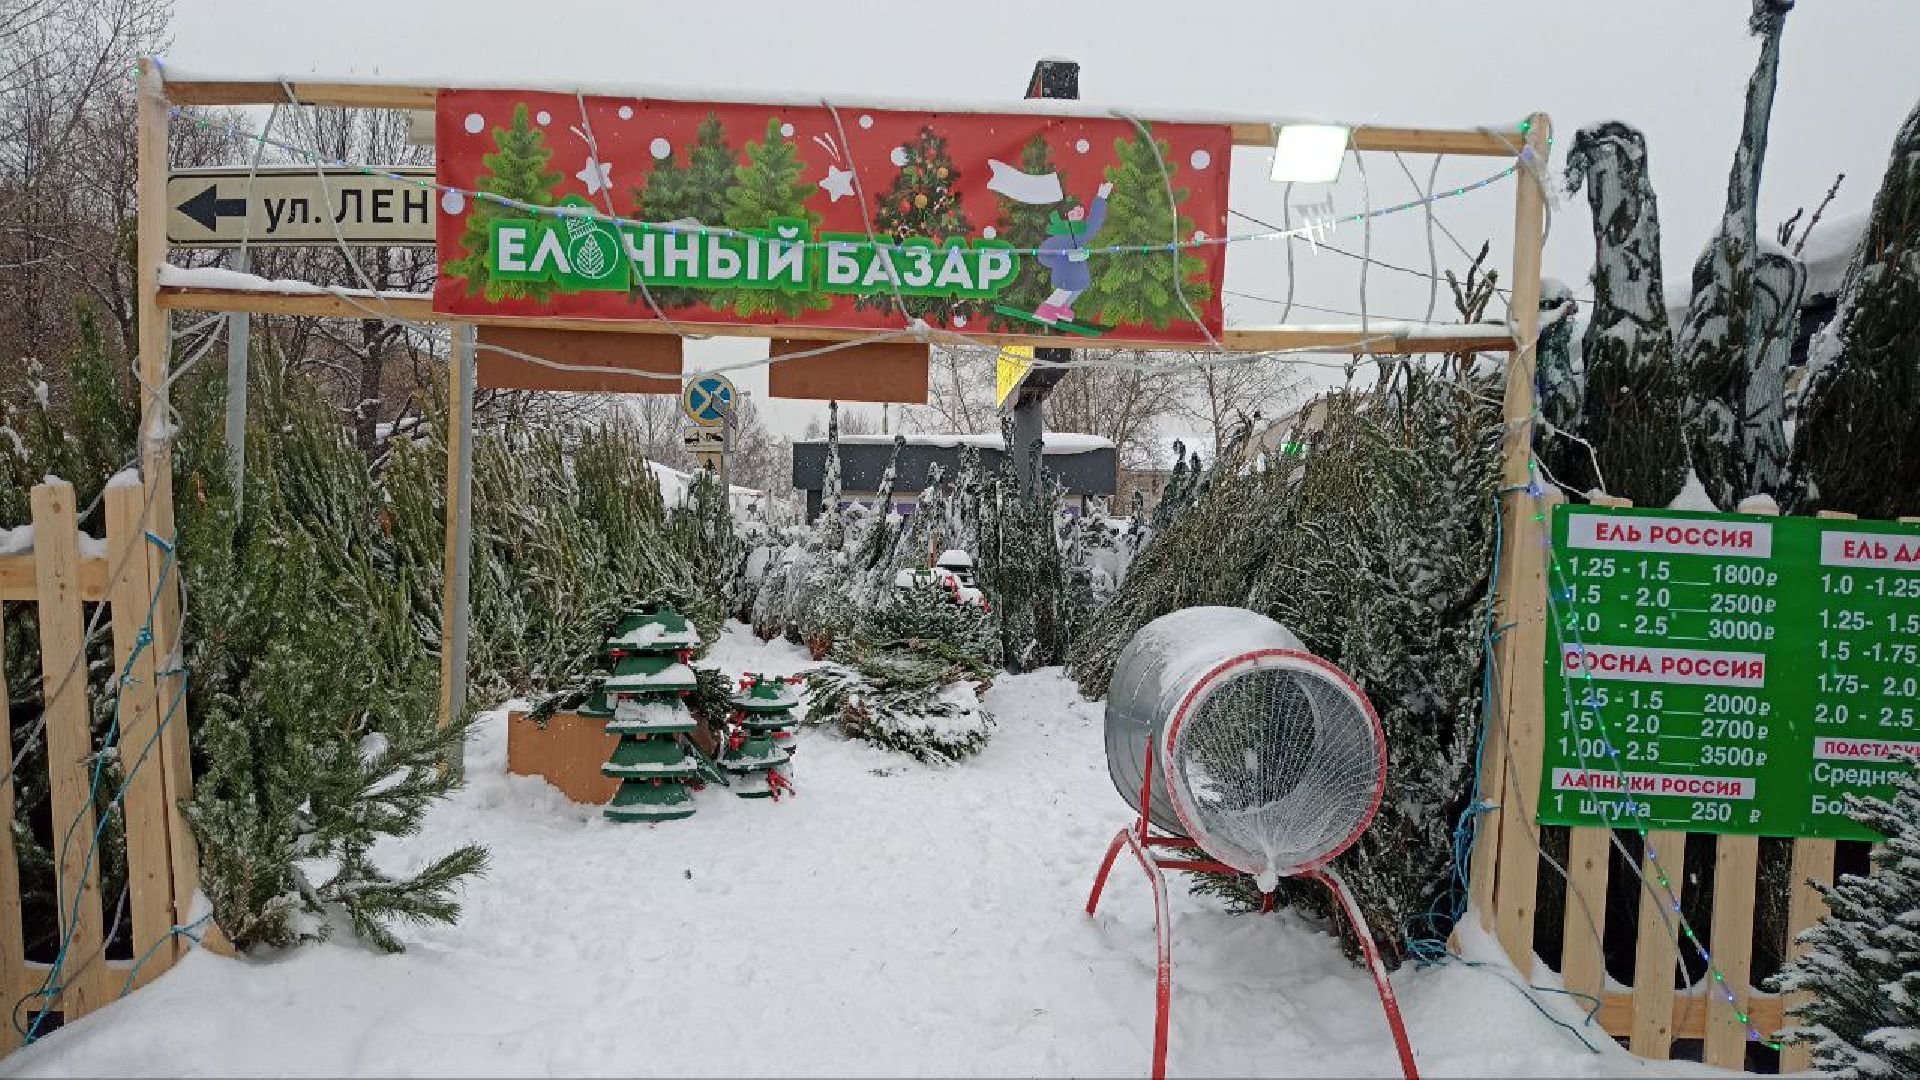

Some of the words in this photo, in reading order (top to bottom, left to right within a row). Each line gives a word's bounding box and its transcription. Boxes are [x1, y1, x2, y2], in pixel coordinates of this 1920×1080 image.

[264, 198, 321, 233] ул.
[335, 189, 428, 223] ЛЕН
[828, 241, 1014, 289] БАЗАР
[1596, 523, 1642, 542] ЕЛЬ
[1650, 525, 1753, 548] РОССИЯ
[1844, 540, 1888, 559] ЕЛЬ
[1569, 557, 1616, 577] 1.25
[1821, 573, 1854, 595] 1.0
[1635, 587, 1670, 607] 2.0
[1634, 614, 1668, 635] 2.5
[1887, 612, 1920, 634] 1.5
[1818, 639, 1850, 661] 1.5
[1565, 651, 1653, 673] СОСНА
[1661, 656, 1763, 679] РОССИЯ
[1883, 676, 1916, 697] 2.0
[1630, 689, 1663, 710] 1.5
[1560, 710, 1594, 731] 15
[1815, 703, 1849, 724] 2.0
[1879, 707, 1914, 727] 2.5
[1626, 741, 1660, 761] 2.5
[1561, 771, 1655, 791] ЛАПНИКИ
[1662, 777, 1742, 796] РОССИЯ
[1554, 794, 1564, 814] 1
[1580, 798, 1651, 821] штука
[1691, 801, 1732, 823] 250
